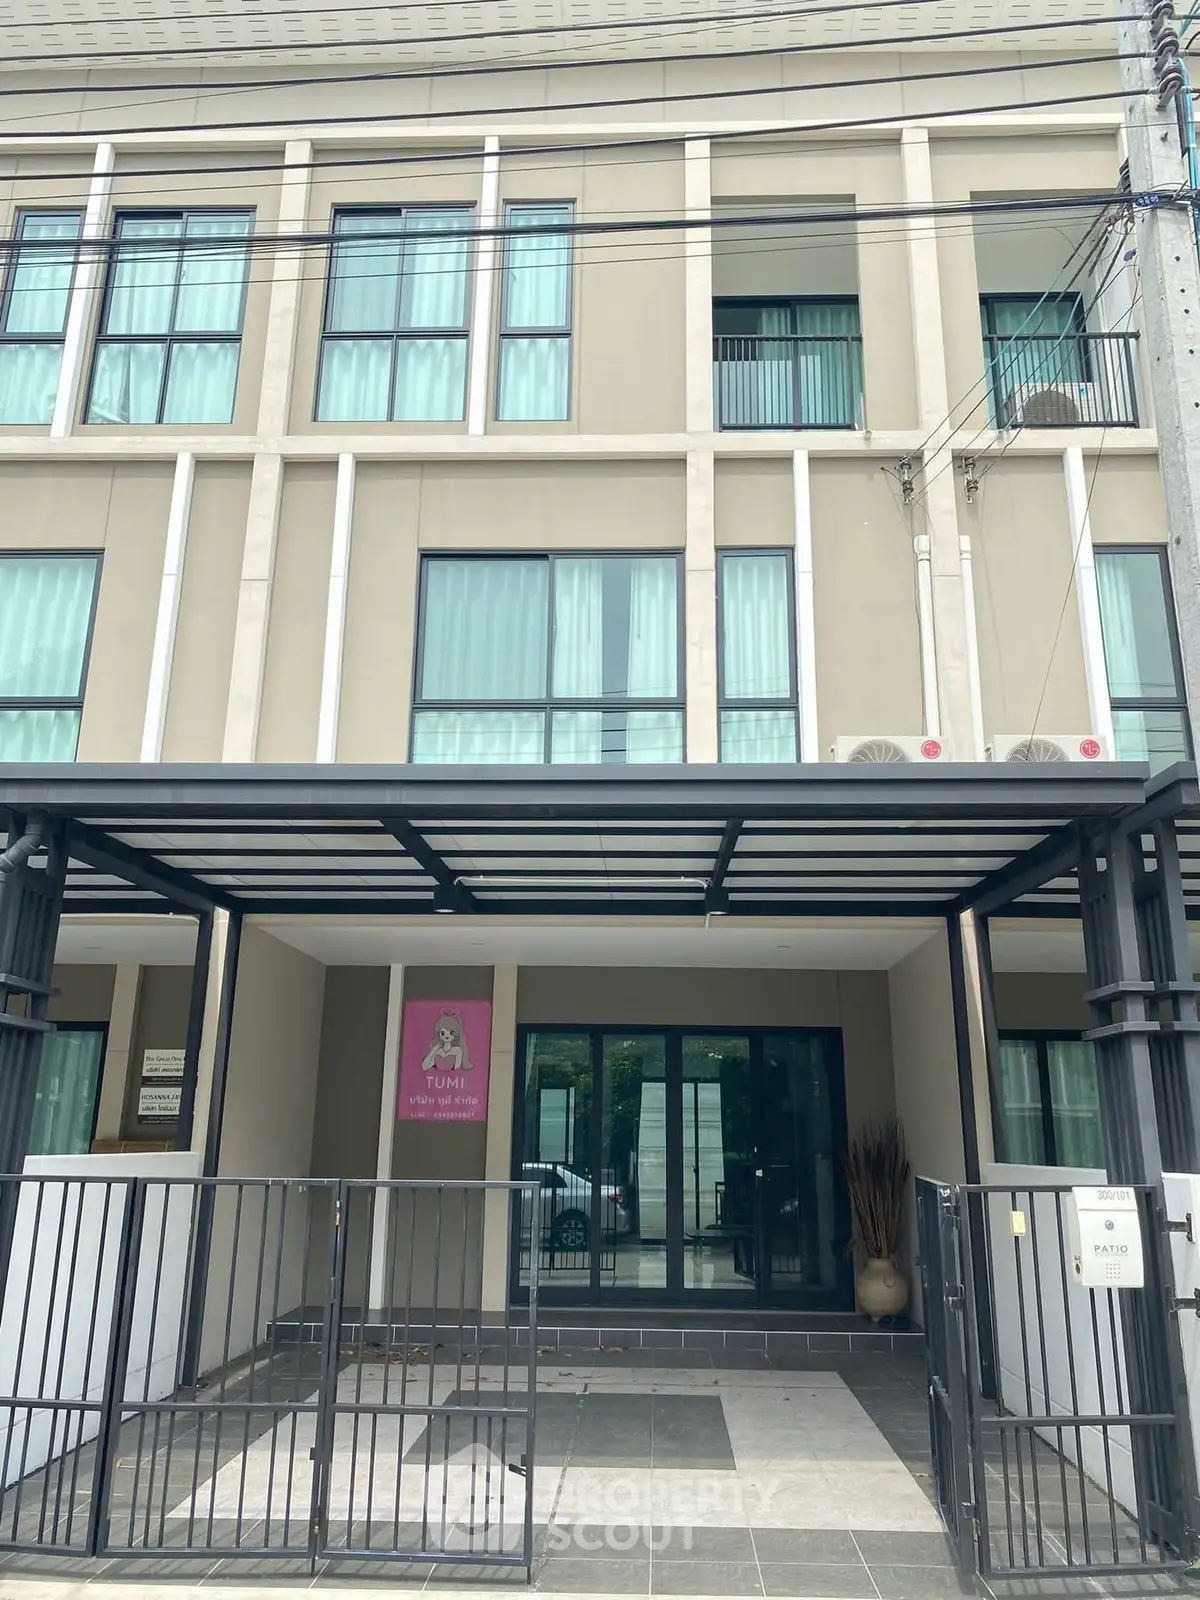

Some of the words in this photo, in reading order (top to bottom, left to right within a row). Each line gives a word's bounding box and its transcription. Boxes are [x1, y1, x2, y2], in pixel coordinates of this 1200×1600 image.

[425, 1076, 465, 1089] TUMI
[1097, 1189, 1132, 1201] 300/101
[1094, 1245, 1129, 1253] PATIO
